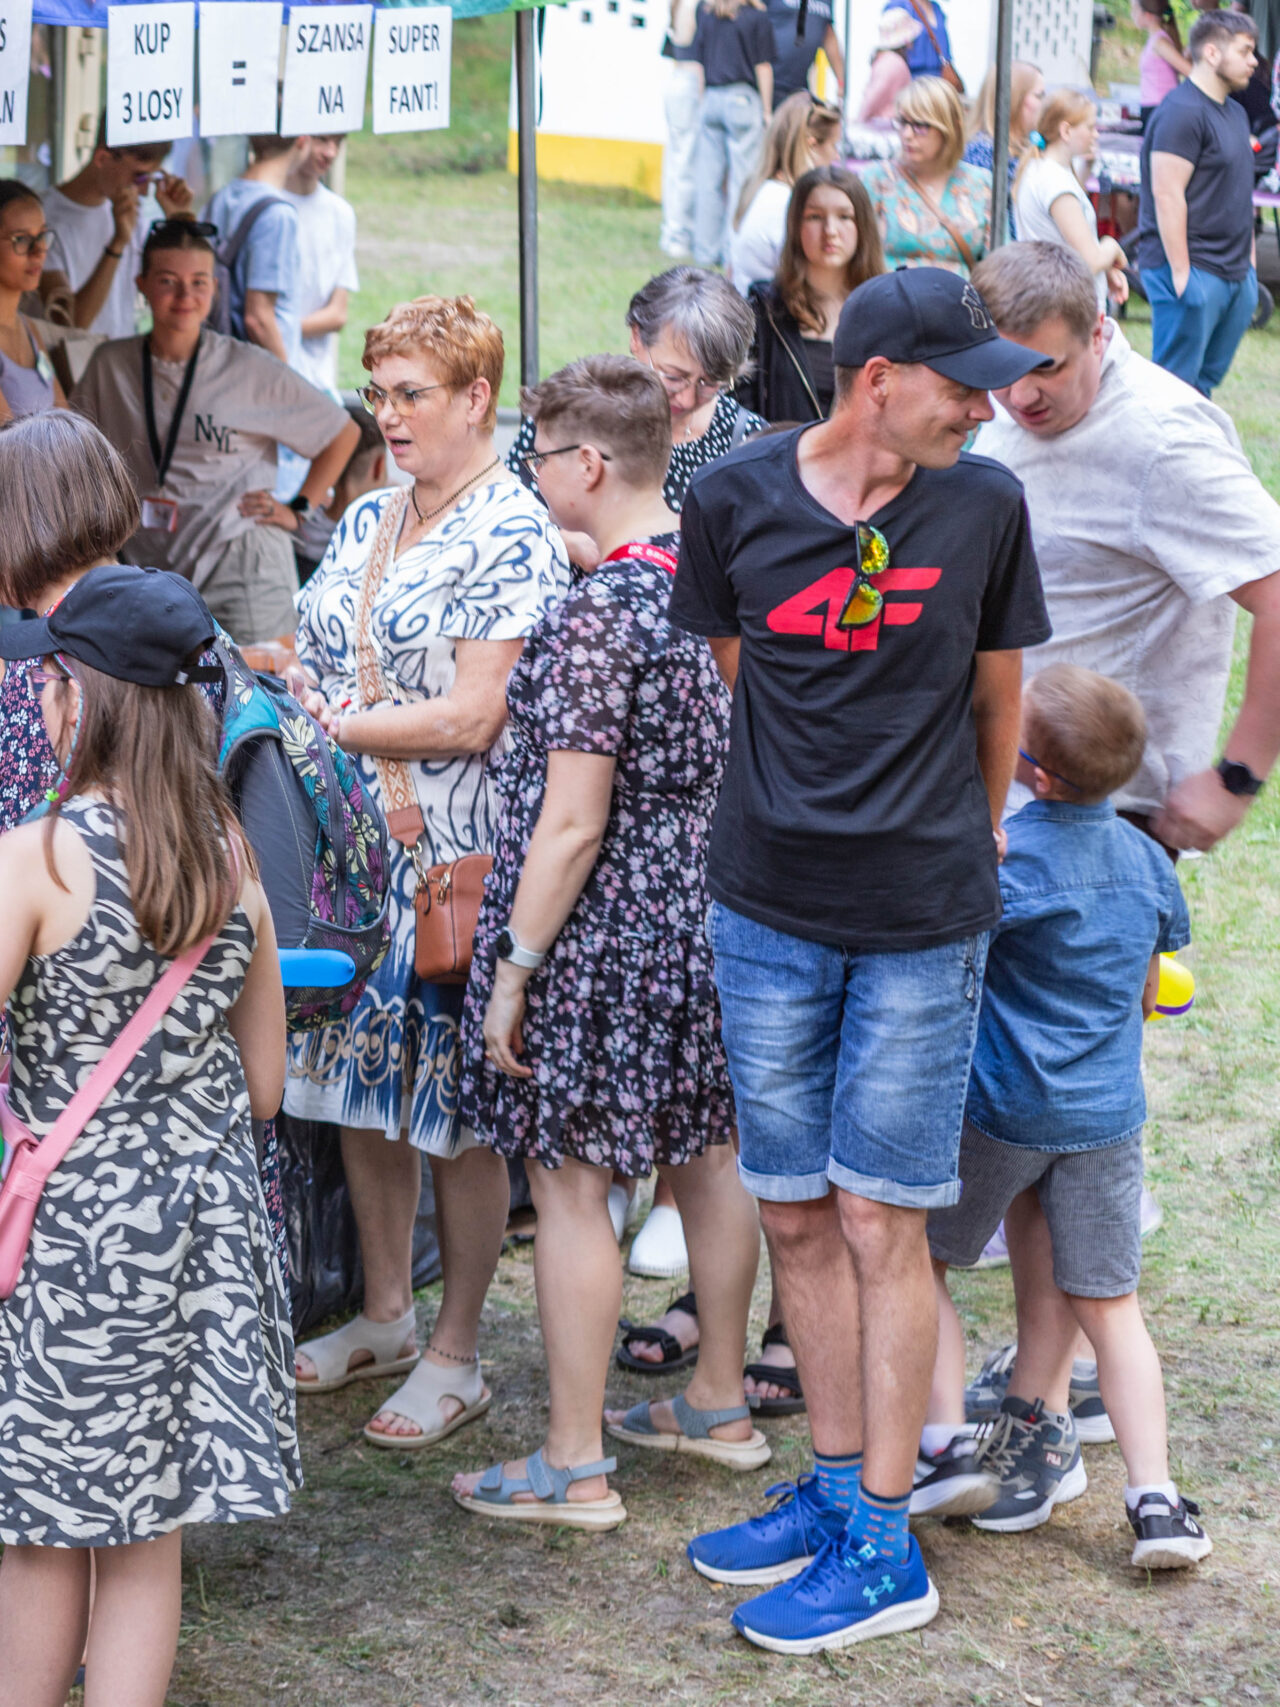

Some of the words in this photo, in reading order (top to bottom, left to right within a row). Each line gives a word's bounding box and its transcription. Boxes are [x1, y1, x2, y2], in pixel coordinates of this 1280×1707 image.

[134, 22, 171, 55] KUP
[296, 22, 364, 53] SZANSA
[389, 24, 440, 54] SUPER
[122, 91, 133, 124] 3
[138, 87, 183, 122] LOSY
[318, 84, 344, 114] NA
[390, 81, 438, 114] FANT!
[194, 413, 239, 454] NYC
[766, 566, 943, 652] 4F
